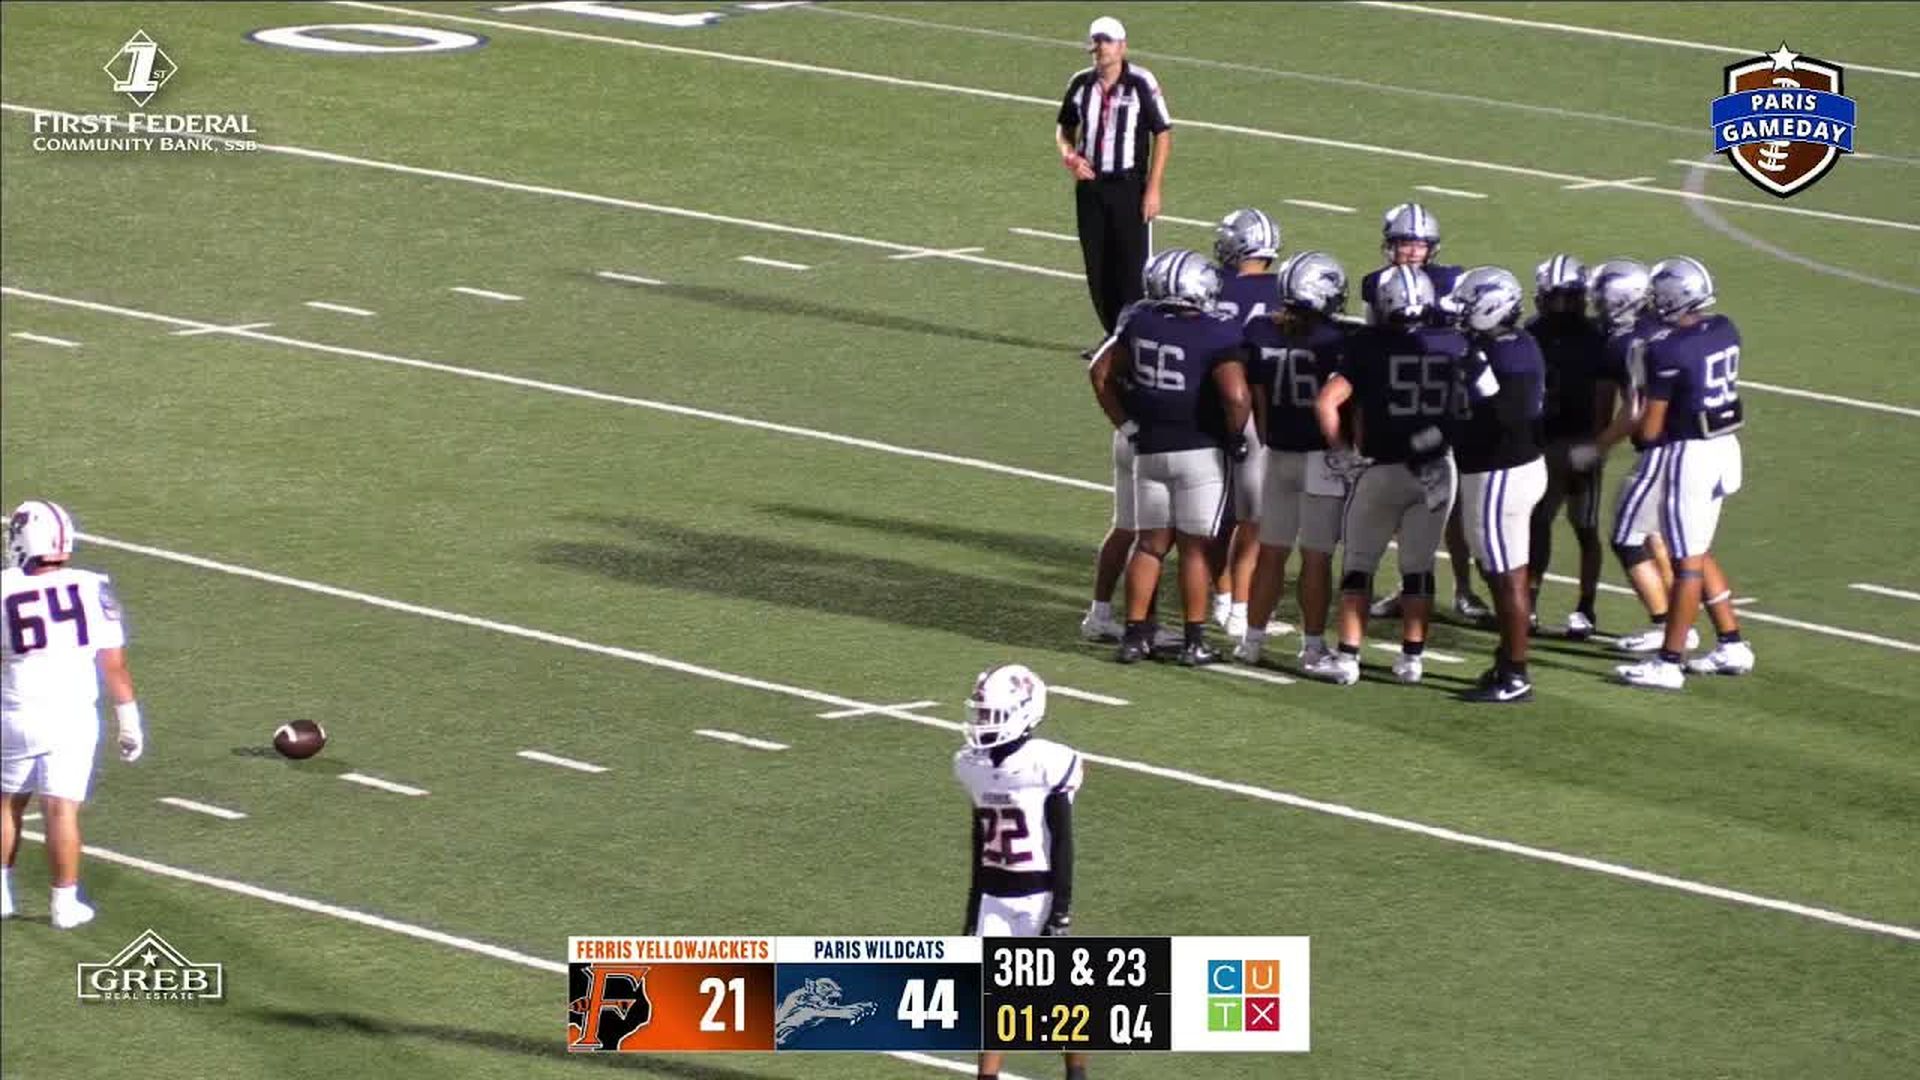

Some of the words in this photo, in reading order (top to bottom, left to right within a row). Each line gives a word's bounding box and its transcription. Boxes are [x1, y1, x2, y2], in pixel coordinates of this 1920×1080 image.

[1133, 337, 1186, 392] 56
[1261, 347, 1318, 408] 76
[1387, 355, 1449, 416] 55
[5, 583, 89, 655] 64
